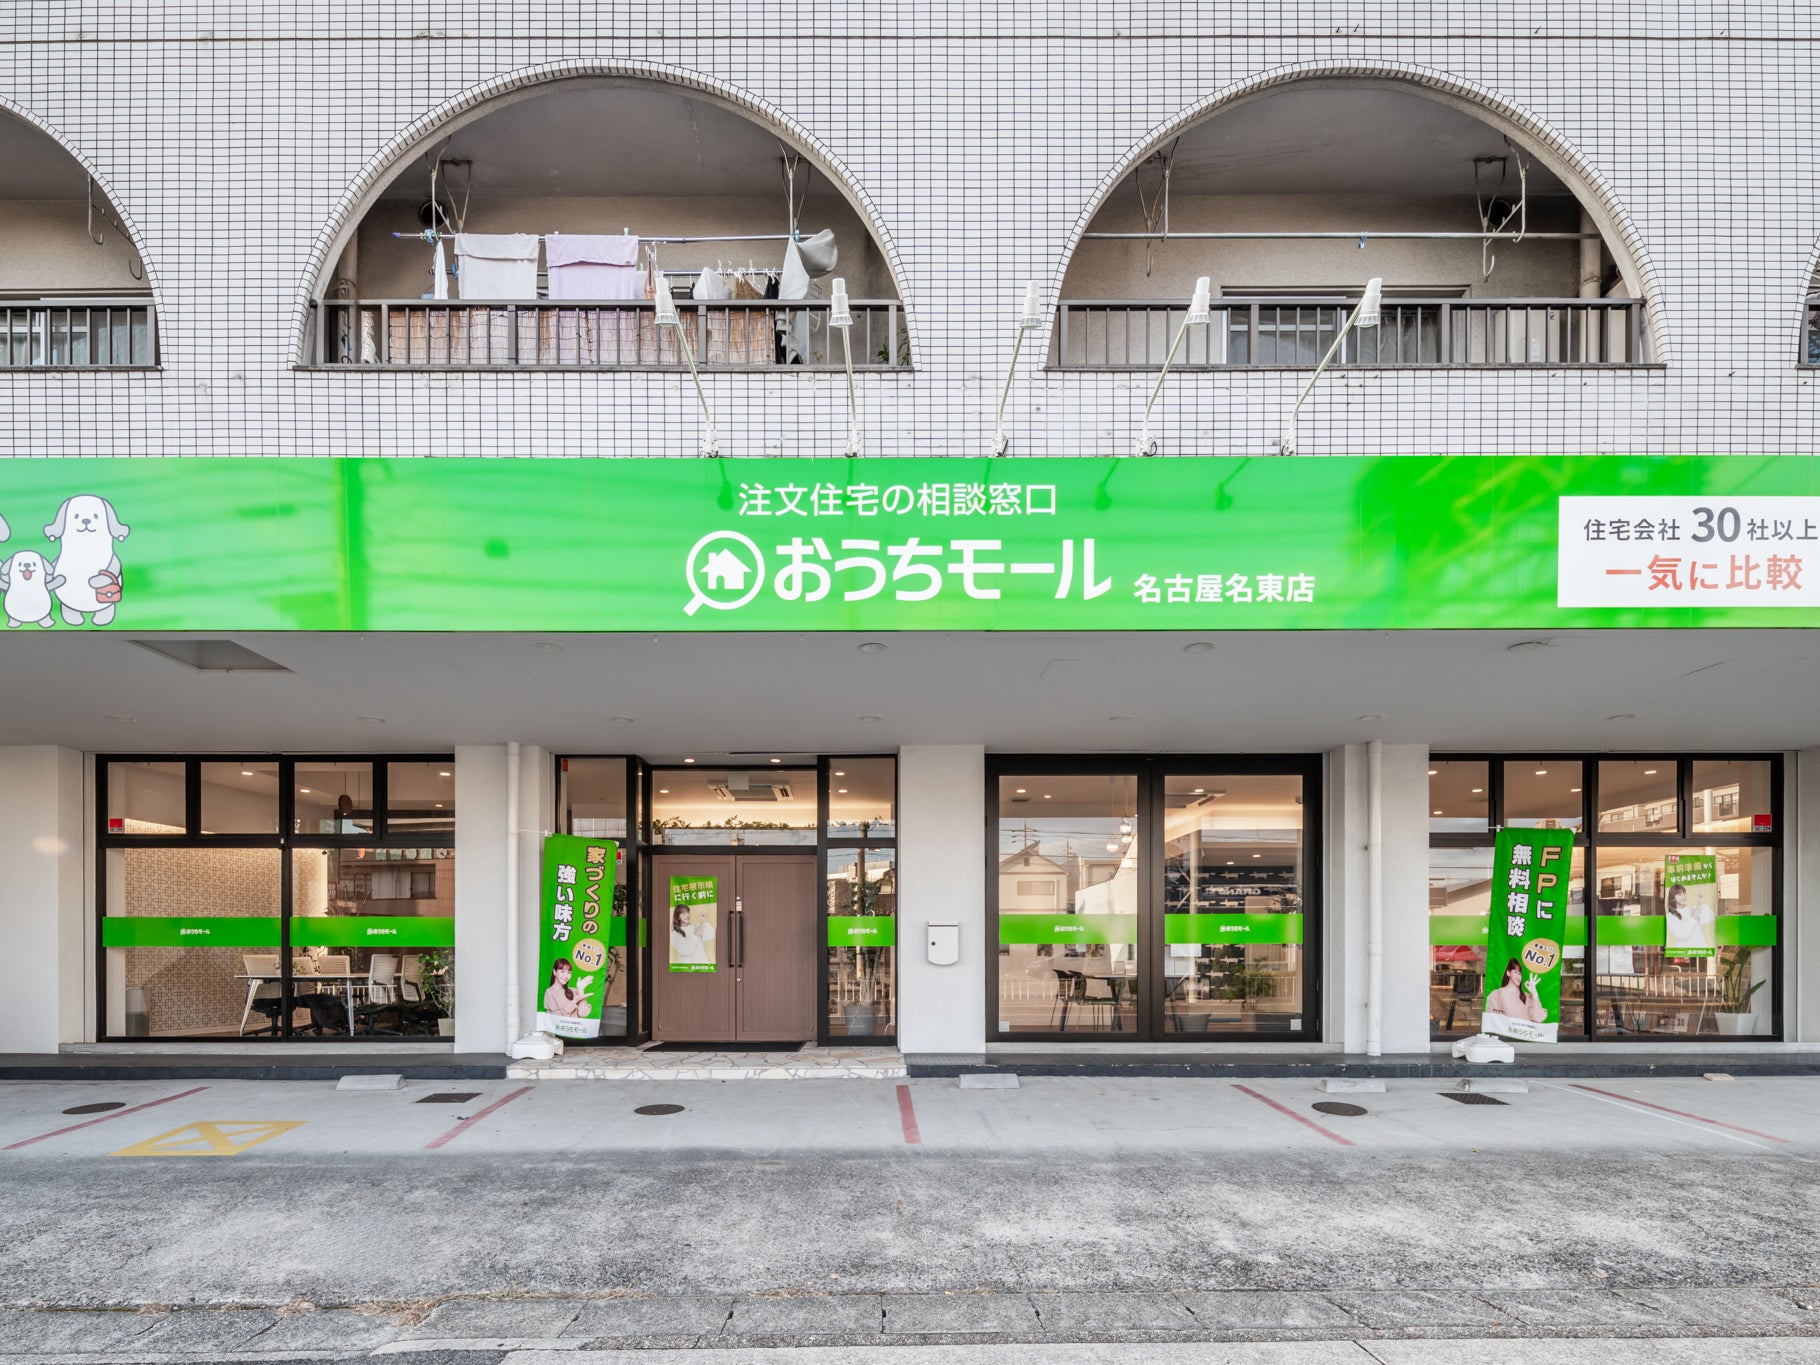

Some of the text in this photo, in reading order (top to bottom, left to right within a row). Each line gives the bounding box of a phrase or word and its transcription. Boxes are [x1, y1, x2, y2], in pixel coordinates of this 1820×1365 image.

[738, 482, 1057, 517] 注文住宅の相談窓口
[773, 536, 1113, 603] おうちモール
[1132, 571, 1317, 604] 名古屋名東店
[1605, 554, 1803, 591] 一気に比較
[582, 846, 607, 935] 家づくりの
[674, 890, 714, 902] に行く前に
[1507, 843, 1532, 937] 無料相談
[1536, 846, 1562, 919] FPに
[552, 864, 577, 942] 強い味方
[575, 949, 602, 967] No.1
[1524, 949, 1556, 968] No.1
